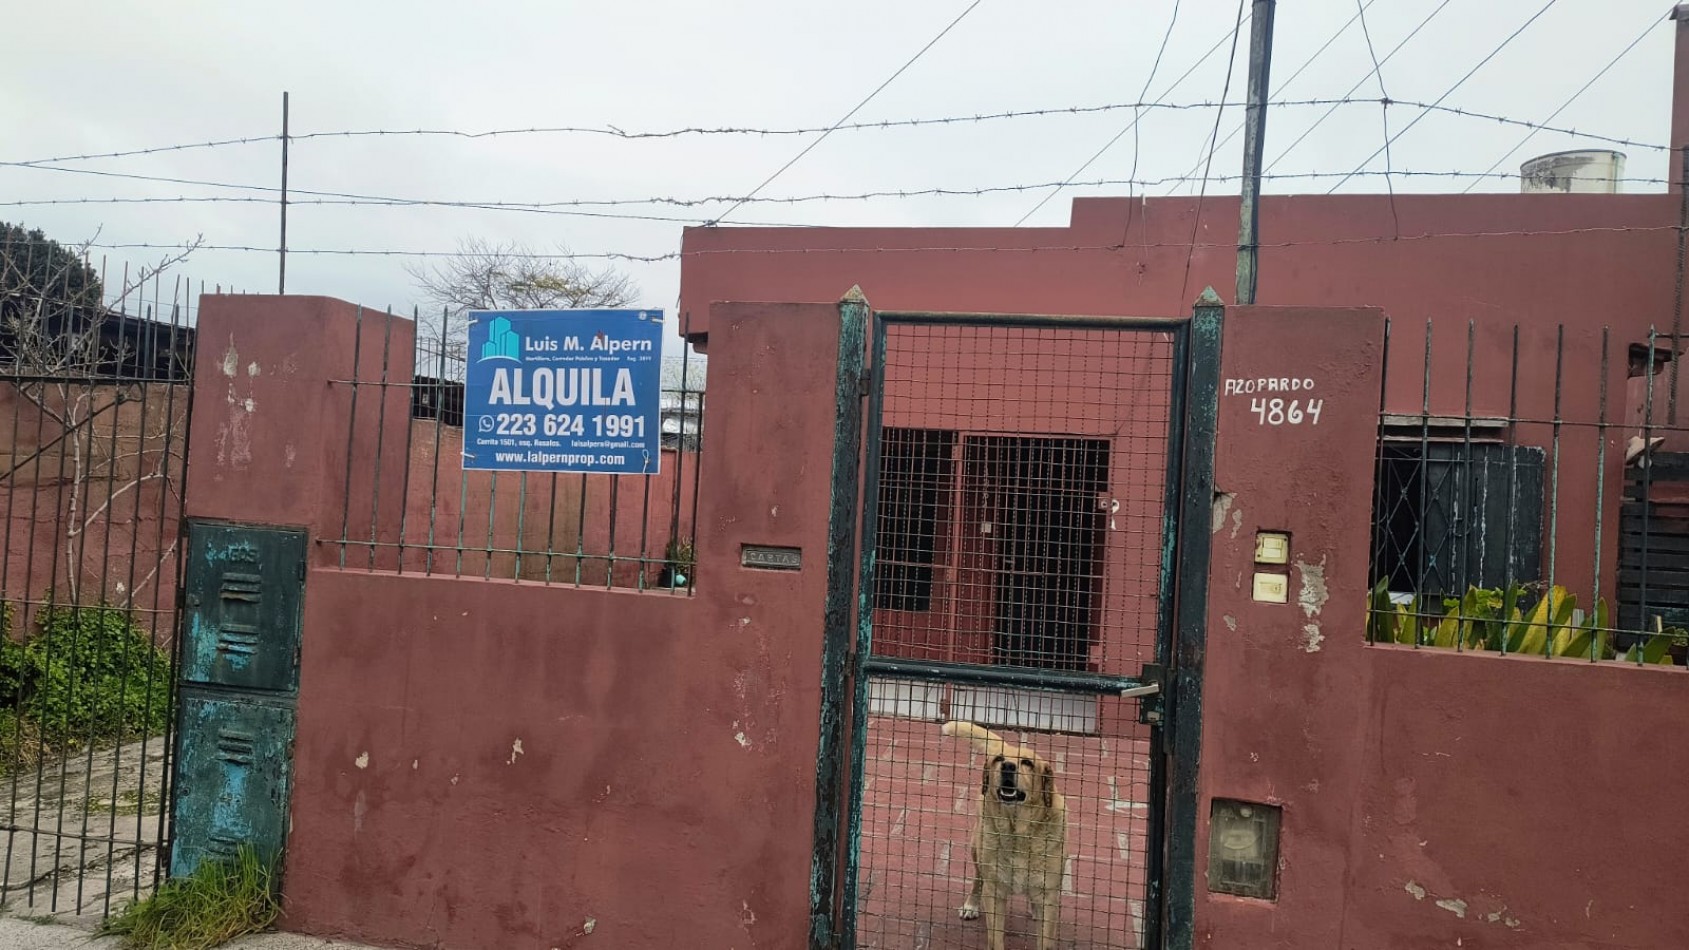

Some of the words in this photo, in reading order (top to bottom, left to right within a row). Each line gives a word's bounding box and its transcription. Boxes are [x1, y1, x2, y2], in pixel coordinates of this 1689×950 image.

[525, 336, 558, 351] Luis
[564, 337, 584, 351] M.
[590, 335, 652, 355] Alpern
[488, 367, 636, 410] ALQUILA
[1224, 377, 1315, 396] AZOPARDO
[1250, 397, 1323, 425] 4864
[496, 413, 537, 436] 223
[543, 414, 584, 437] 624
[592, 415, 645, 438] 1991
[495, 450, 625, 467] www.lalpernprop.com
